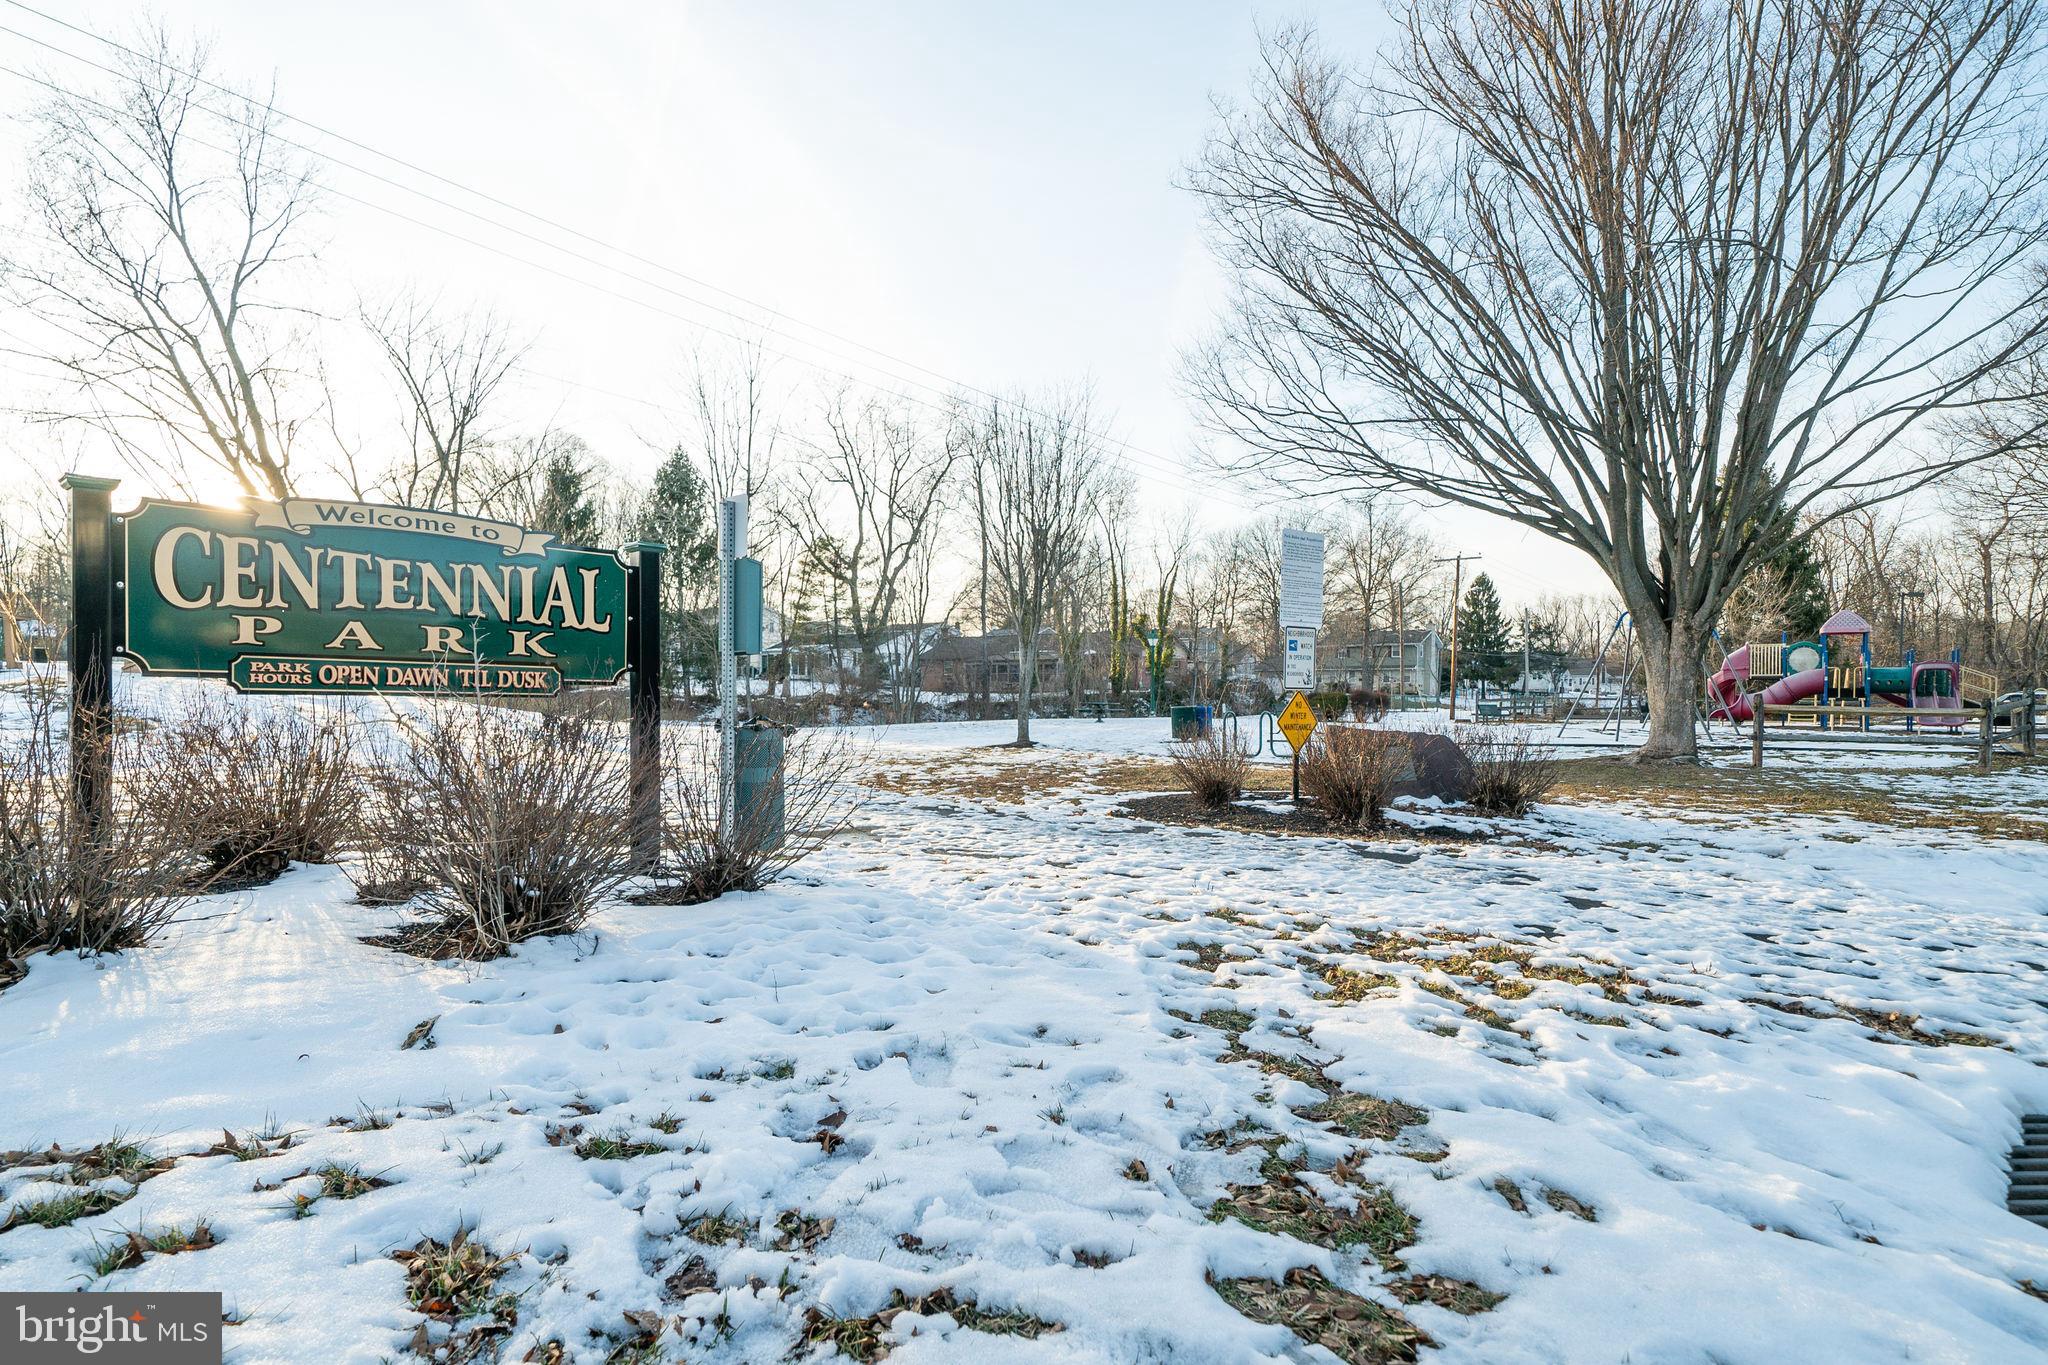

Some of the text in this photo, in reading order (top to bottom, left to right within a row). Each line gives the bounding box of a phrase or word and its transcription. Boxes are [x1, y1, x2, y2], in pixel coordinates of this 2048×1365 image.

[315, 503, 500, 541] Welcome to
[154, 526, 611, 633] CENTENNIAL
[231, 614, 557, 658] PARK
[249, 661, 311, 673] PARK
[249, 673, 312, 684] HOURS
[318, 664, 379, 686] OPEN
[386, 666, 450, 688] DAWN
[498, 669, 548, 689] DUSK
[1295, 701, 1302, 709] NO
[1290, 712, 1307, 720] WINTER
[1283, 723, 1312, 731] MAINTENANCE
